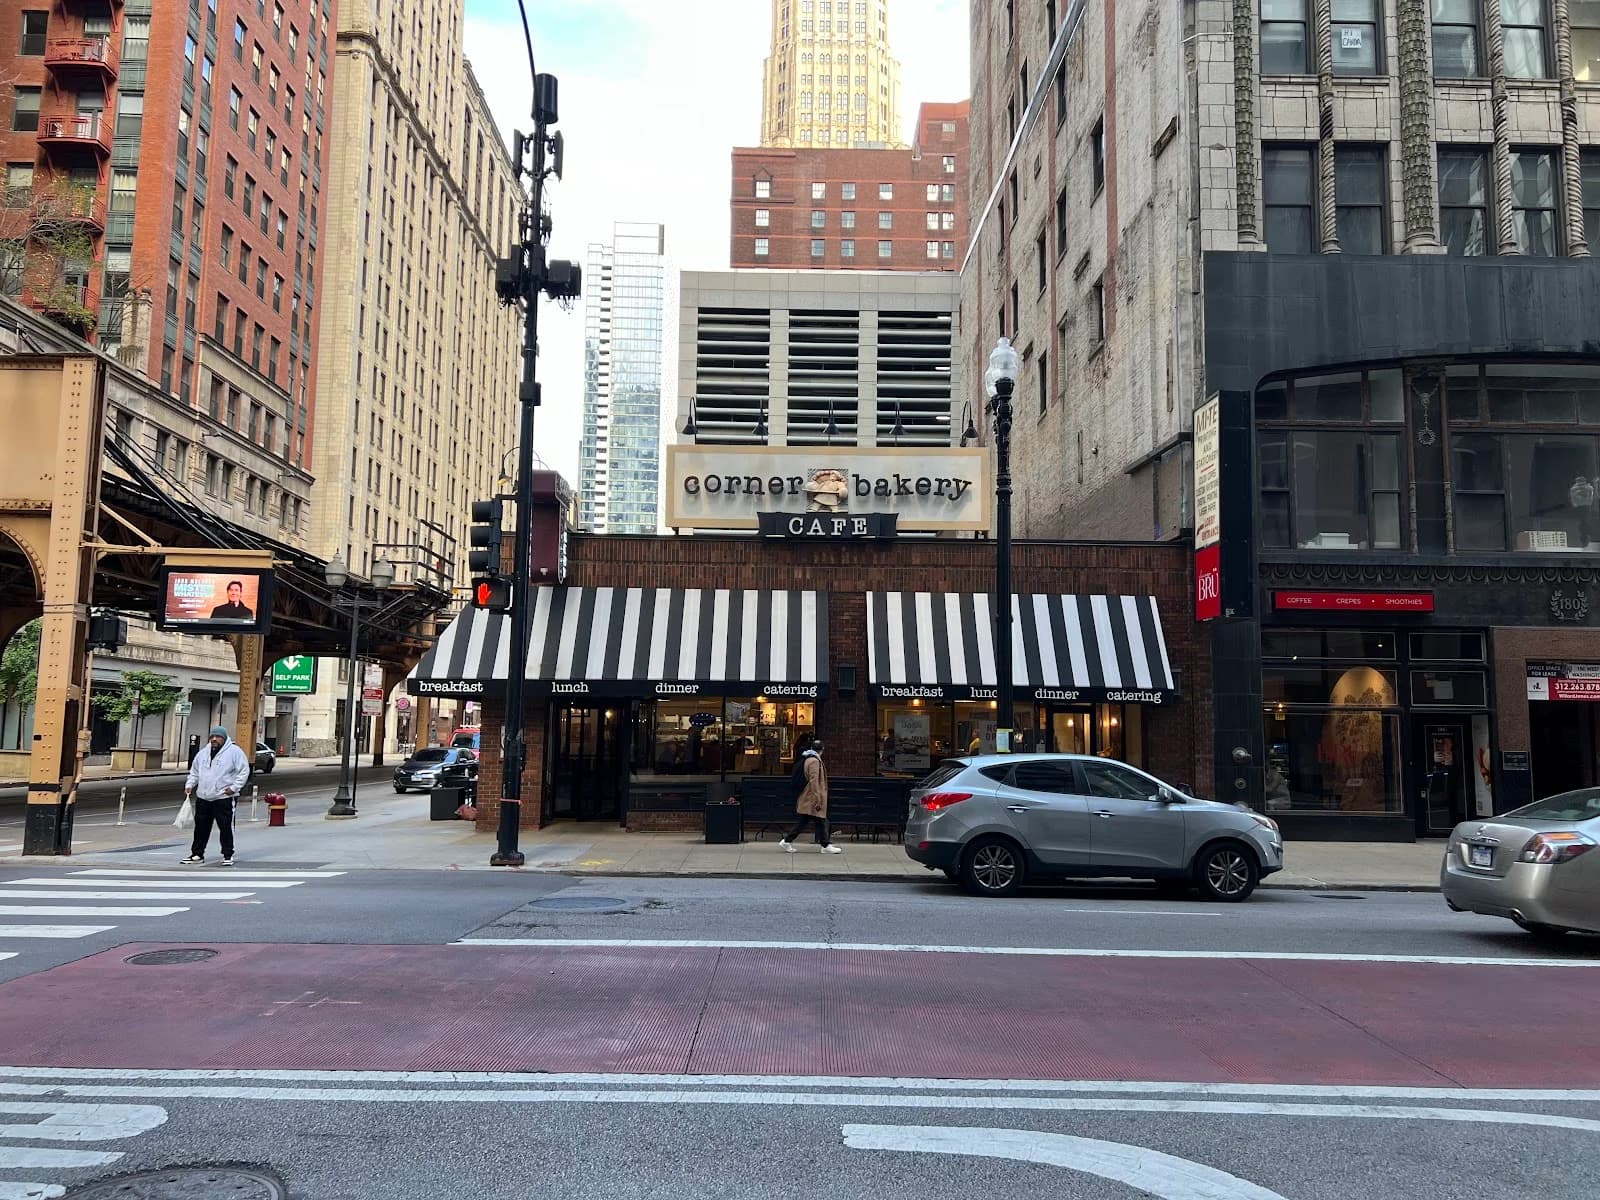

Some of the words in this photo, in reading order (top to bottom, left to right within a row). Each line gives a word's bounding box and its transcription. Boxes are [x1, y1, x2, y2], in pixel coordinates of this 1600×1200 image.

[683, 474, 804, 495] corner
[851, 473, 972, 501] bakery
[788, 517, 868, 535] CAFE
[1198, 568, 1219, 601] BRÜ
[1385, 598, 1423, 606] SMOOTHIES
[1559, 598, 1581, 610] 180
[419, 681, 484, 693] breakfast
[551, 681, 590, 693] lunch
[655, 683, 700, 694] dinner
[763, 684, 818, 697] catering
[881, 685, 944, 697] breakfast
[970, 687, 997, 698] lunc
[1034, 687, 1080, 700] dinner
[1106, 690, 1163, 703] catering
